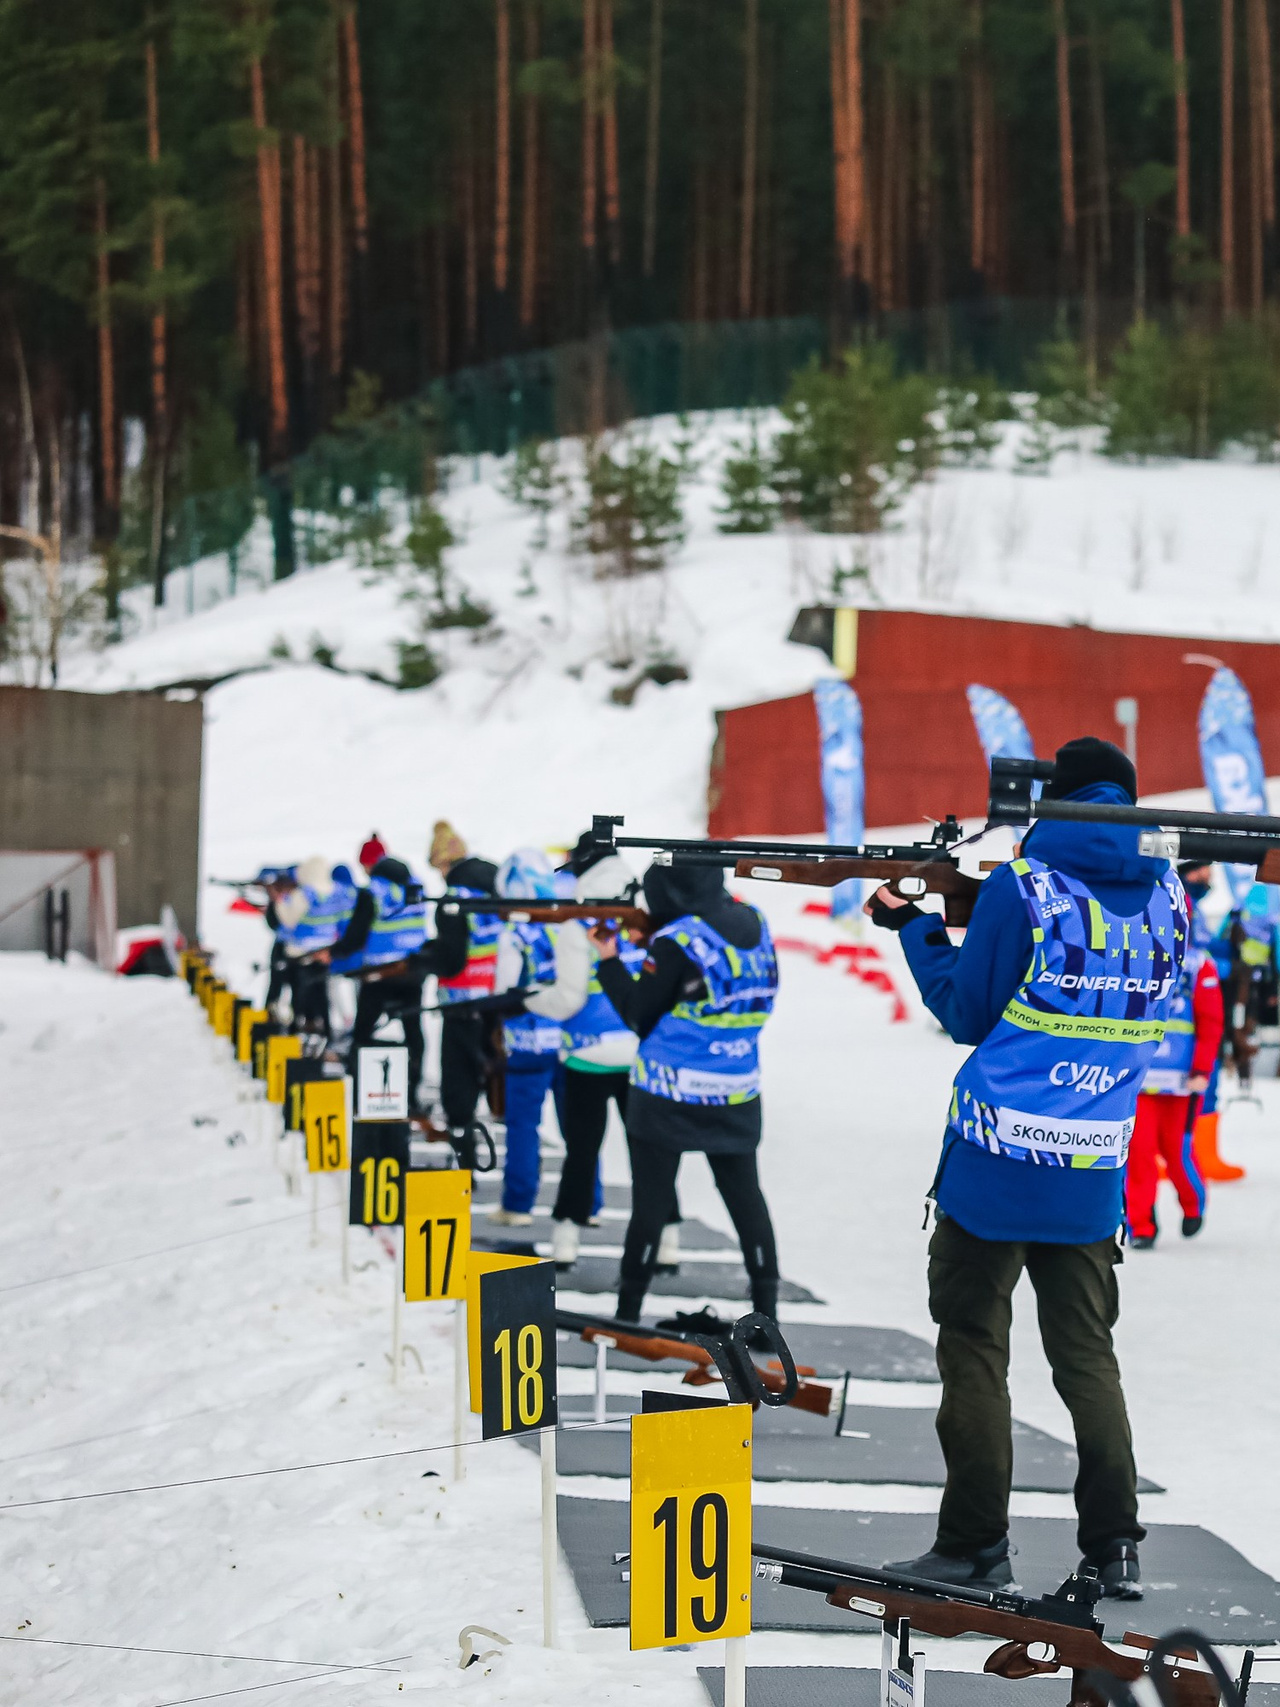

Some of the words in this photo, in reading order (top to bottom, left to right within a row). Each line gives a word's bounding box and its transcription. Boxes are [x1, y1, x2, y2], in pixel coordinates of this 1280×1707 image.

[1037, 970, 1121, 992] PIONER
[1123, 978, 1160, 993] CUP
[1053, 1022, 1073, 1032] ЭТО
[1075, 1024, 1116, 1036] ПРОСТО
[314, 1114, 341, 1169] 15
[359, 1156, 400, 1225] 16
[419, 1217, 458, 1297] 17
[494, 1323, 544, 1432] 18
[653, 1492, 729, 1639] 19
